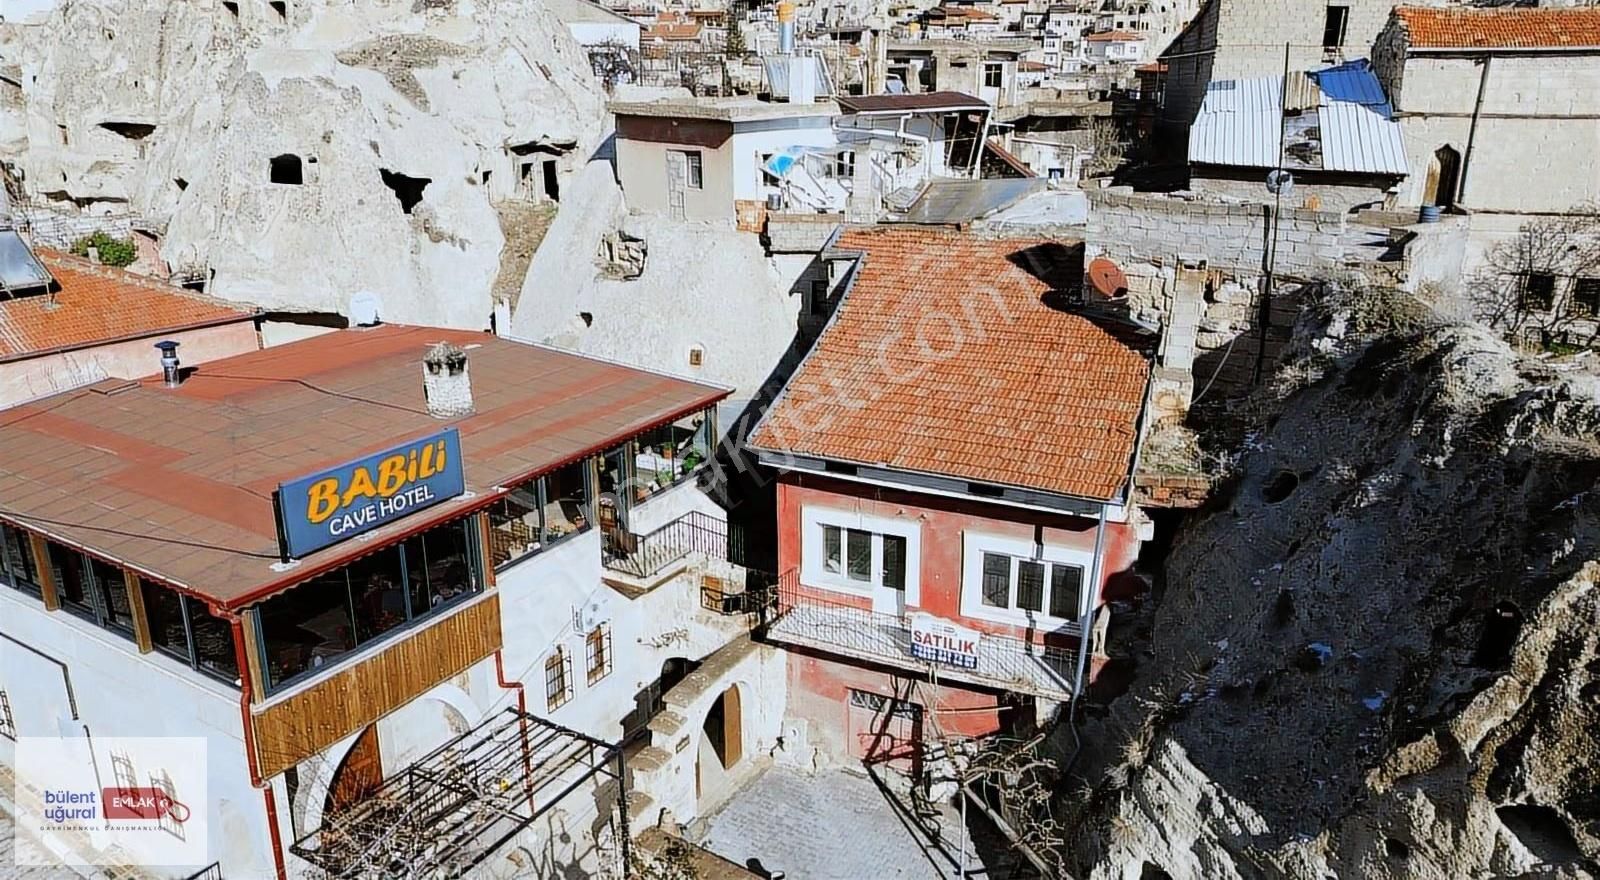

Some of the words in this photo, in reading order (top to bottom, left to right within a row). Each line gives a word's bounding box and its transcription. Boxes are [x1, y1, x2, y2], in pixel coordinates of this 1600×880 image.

[330, 504, 377, 536] CAVE
[379, 485, 435, 517] HOTEL
[914, 630, 975, 655] SATILIK
